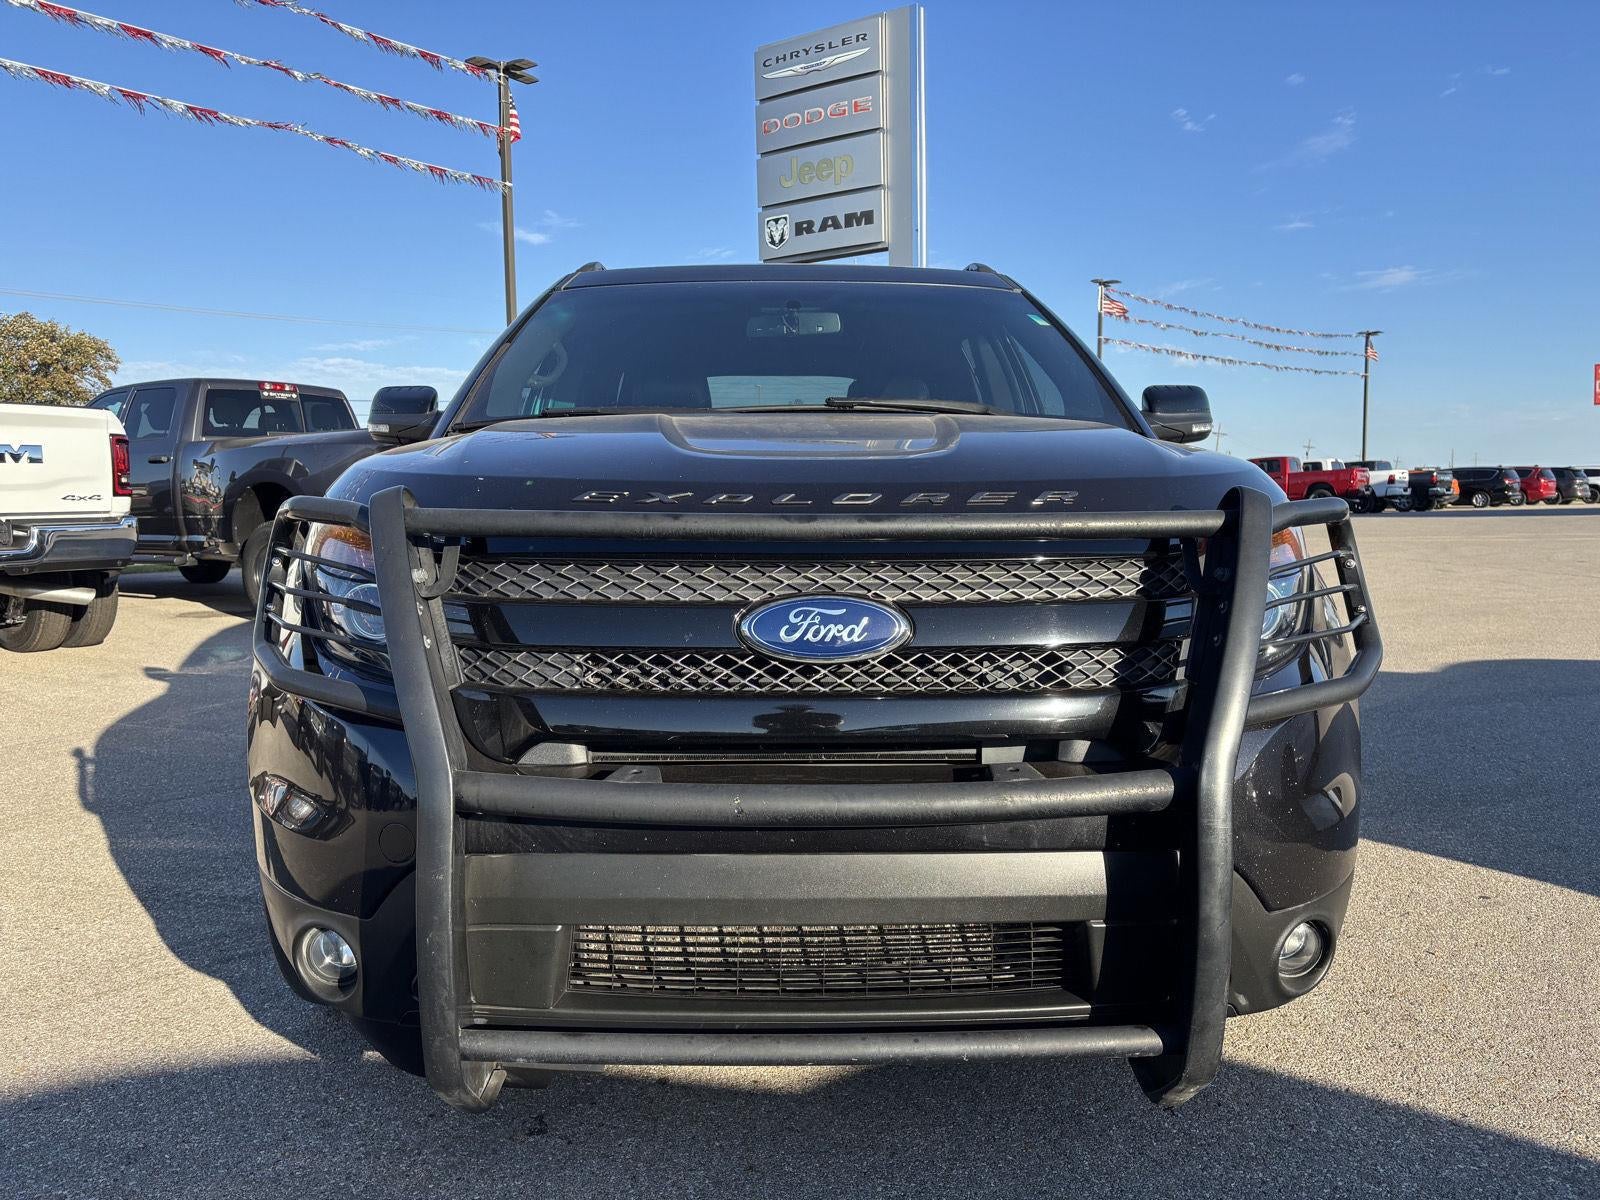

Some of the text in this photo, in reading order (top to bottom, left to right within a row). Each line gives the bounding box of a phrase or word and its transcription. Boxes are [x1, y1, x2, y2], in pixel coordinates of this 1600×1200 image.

[762, 32, 868, 68] CHRYSLER
[762, 96, 872, 136] DODGE
[779, 154, 854, 189] Jeep
[794, 209, 875, 237] RAM
[572, 490, 1079, 506] EXPLORER
[779, 606, 868, 643] Ford
